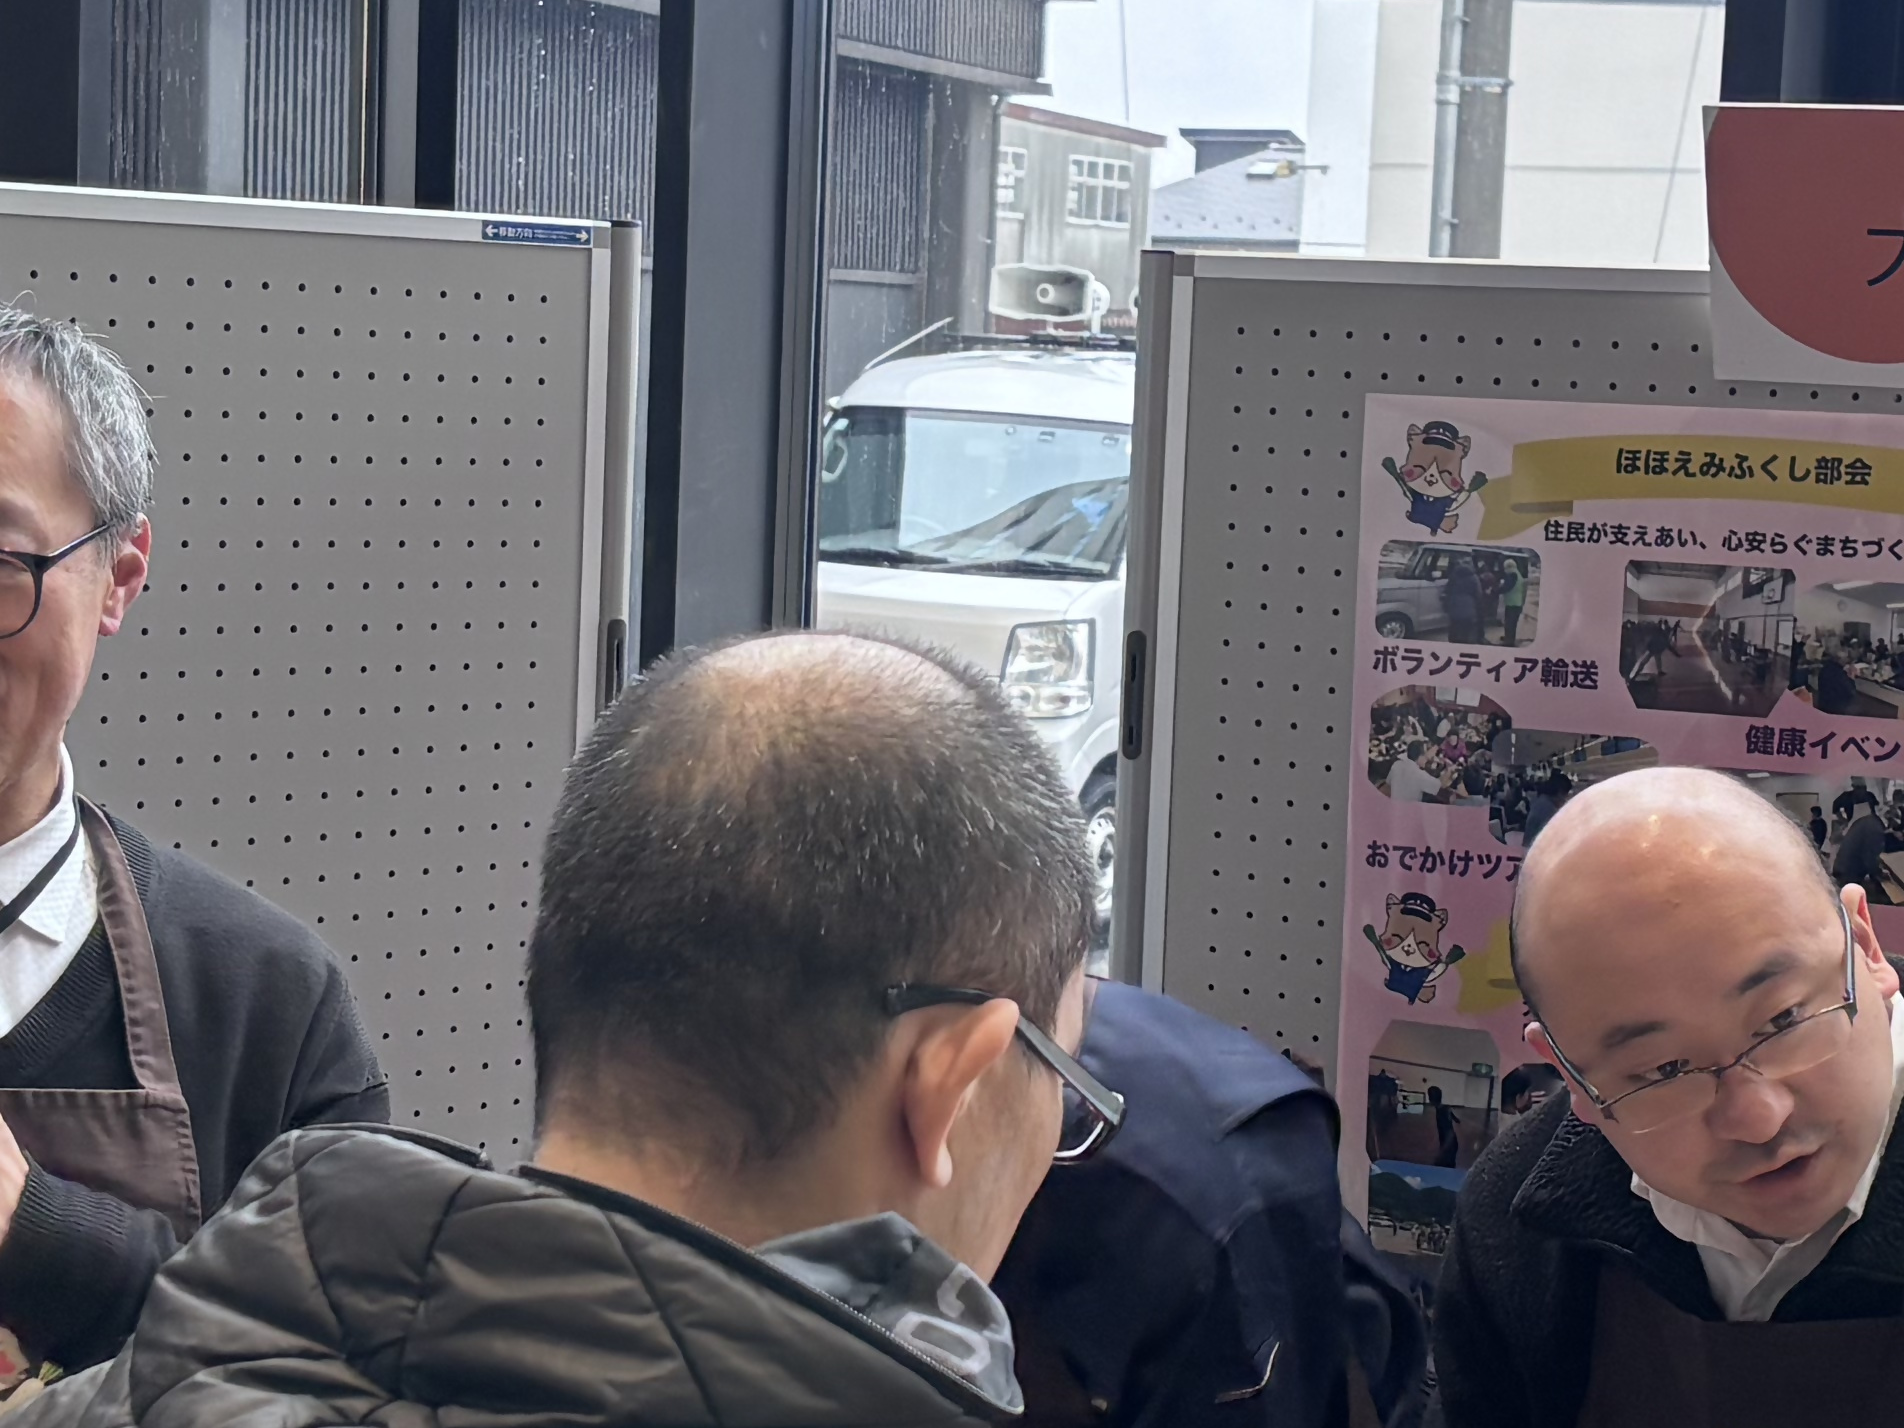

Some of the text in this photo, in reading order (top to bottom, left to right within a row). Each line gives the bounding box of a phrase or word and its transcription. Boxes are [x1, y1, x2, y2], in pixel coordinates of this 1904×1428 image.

[1615, 446, 1873, 487] ほほえみふくし部会
[1372, 644, 1599, 691] ボランティア輸送
